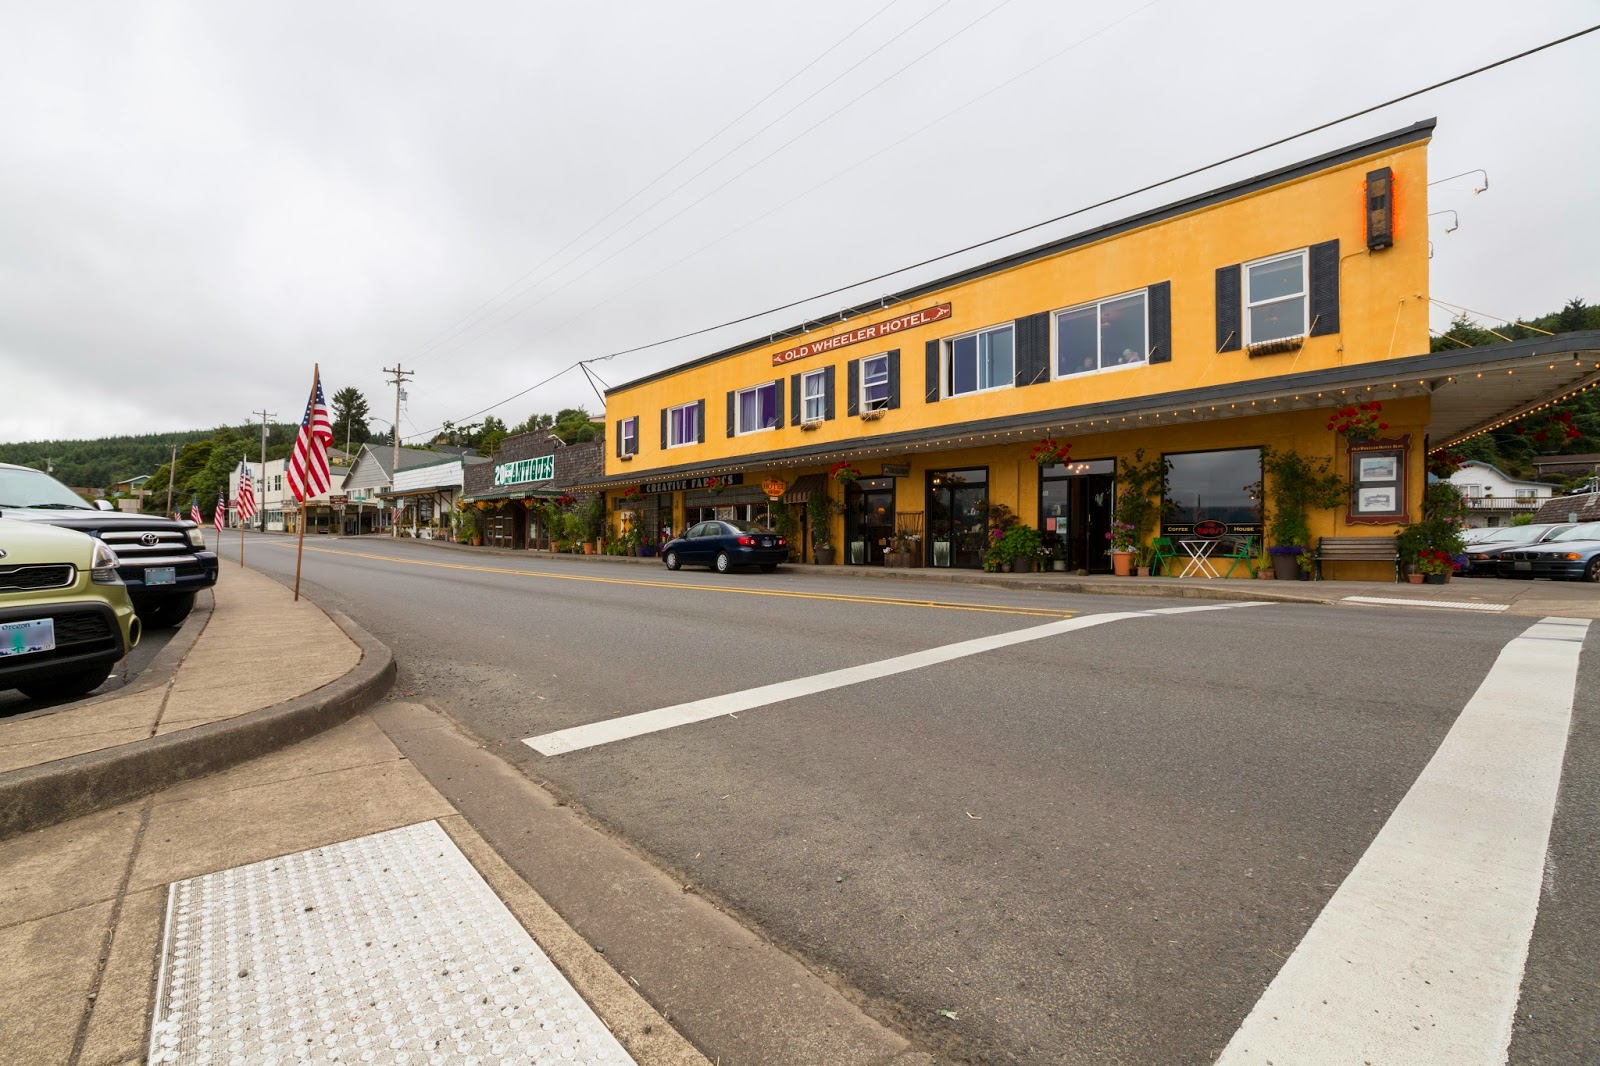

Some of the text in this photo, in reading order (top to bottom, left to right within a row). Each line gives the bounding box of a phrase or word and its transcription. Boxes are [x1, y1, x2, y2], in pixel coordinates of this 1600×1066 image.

[785, 312, 931, 361] OLD WHEELER HOTEL
[495, 464, 505, 485] 20
[511, 456, 553, 482] ANTIQUES
[646, 480, 687, 493] CREATIVE
